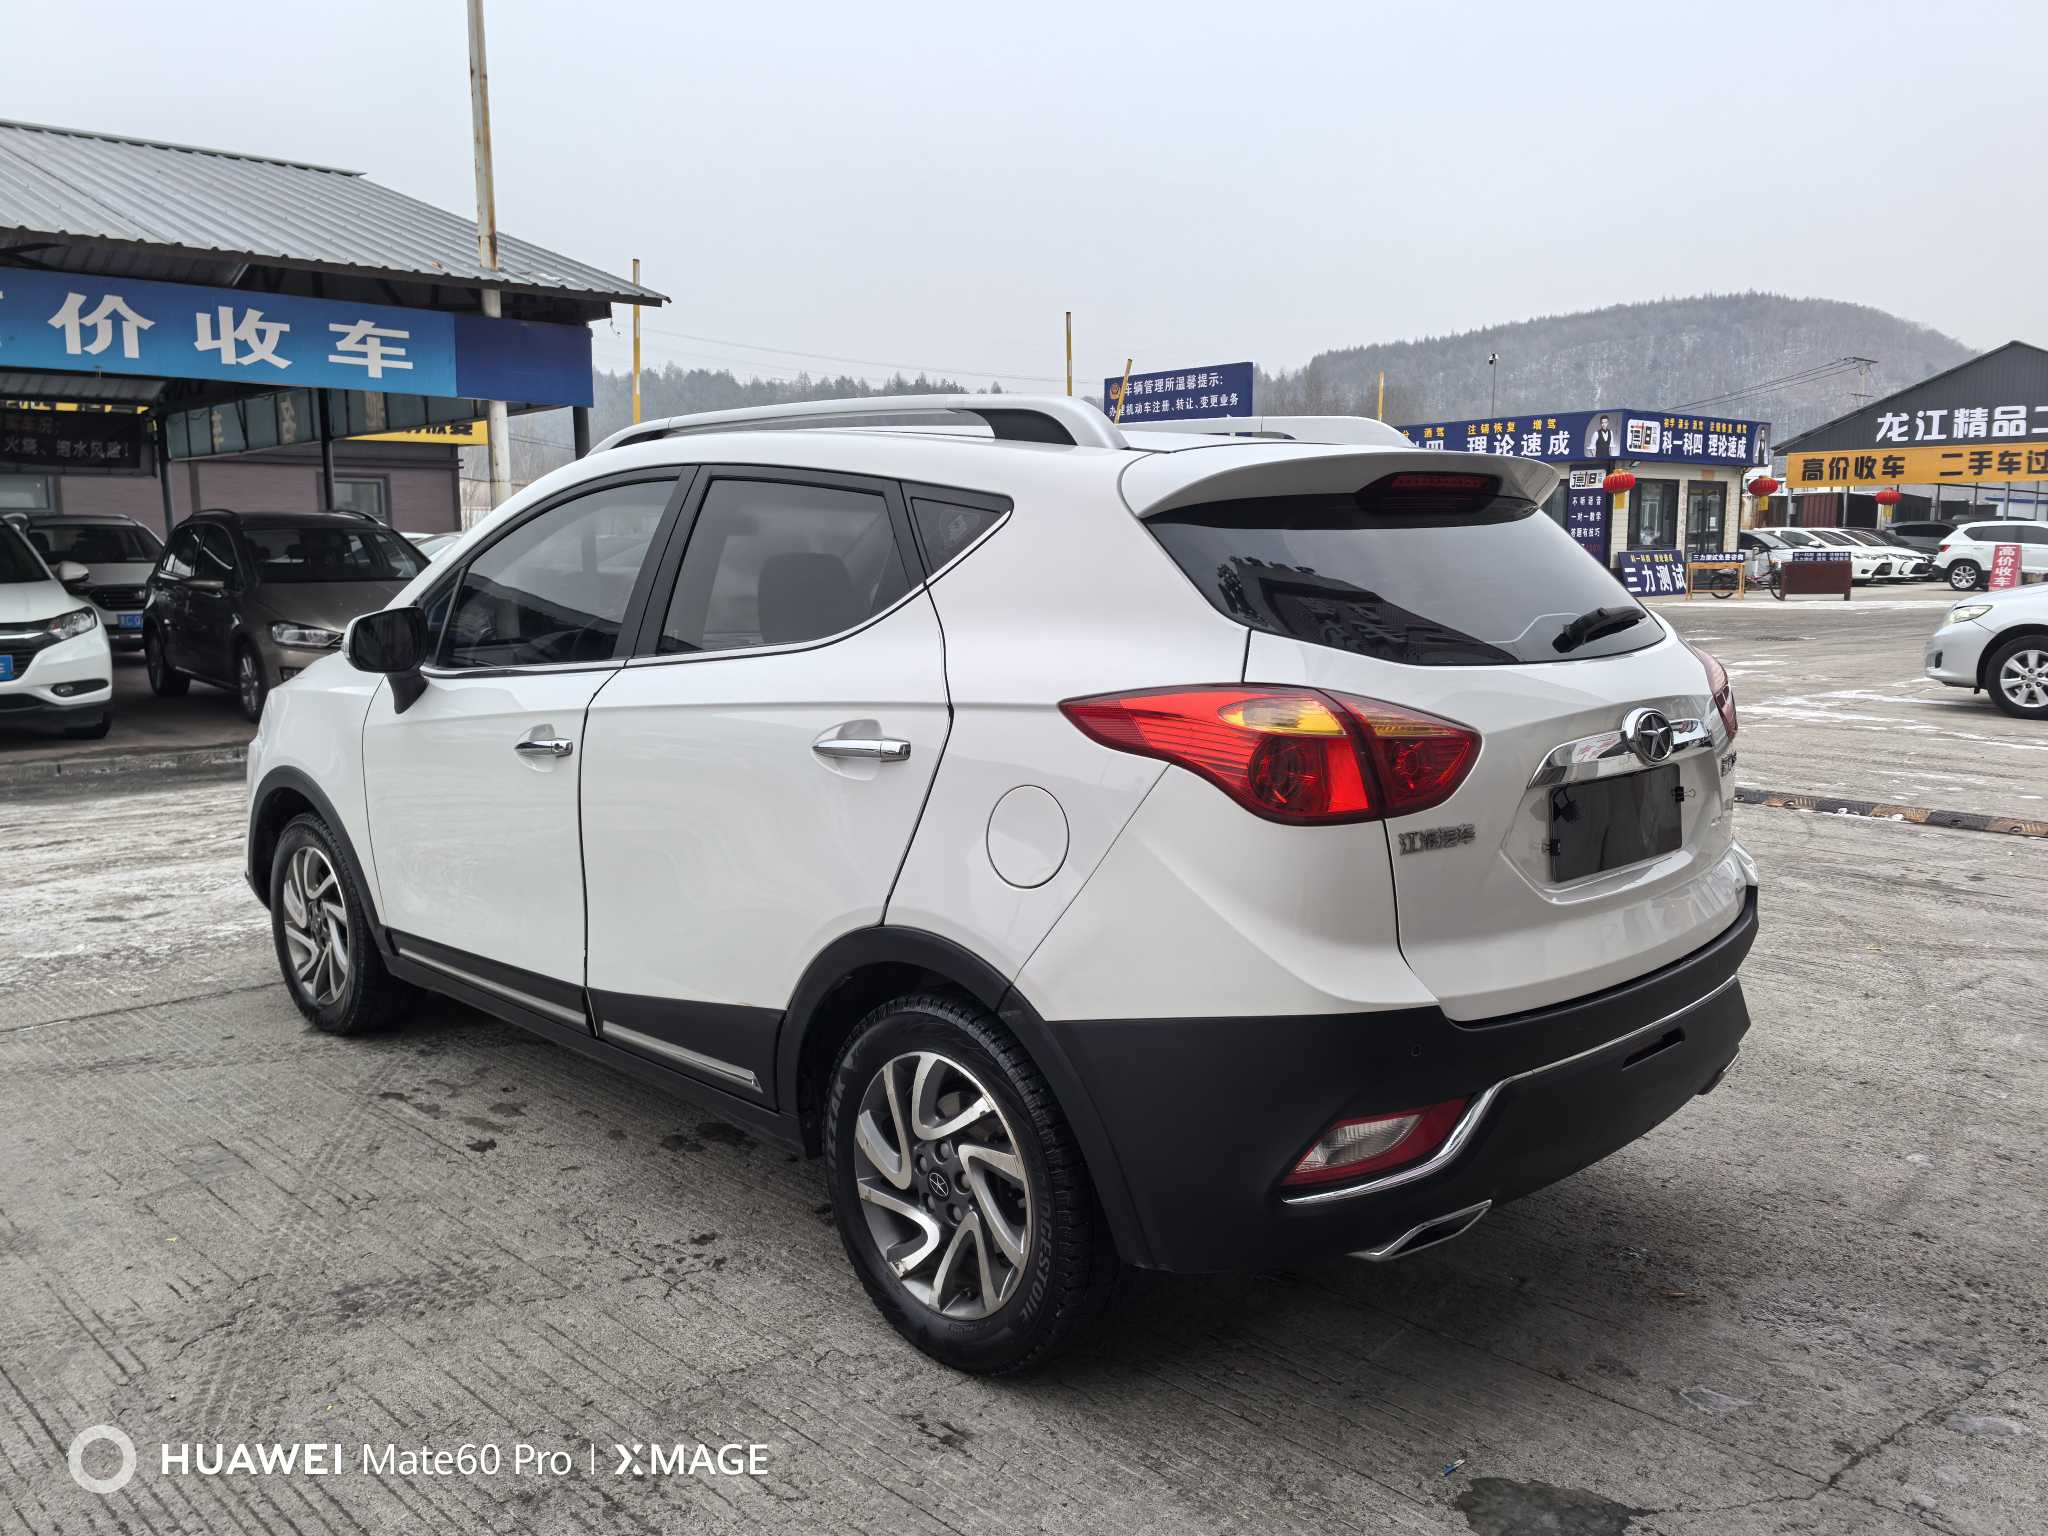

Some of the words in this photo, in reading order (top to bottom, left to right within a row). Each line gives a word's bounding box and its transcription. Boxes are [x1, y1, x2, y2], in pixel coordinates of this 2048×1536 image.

[0, 292, 413, 378] 价收车
[1467, 431, 1571, 457] 理论速成
[1662, 430, 1702, 455] 科一科四
[1708, 434, 1747, 459] 理论速成
[1802, 455, 1905, 481] 高价收车
[1624, 563, 1687, 593] 三力测试
[1992, 546, 2016, 586] 高价收车
